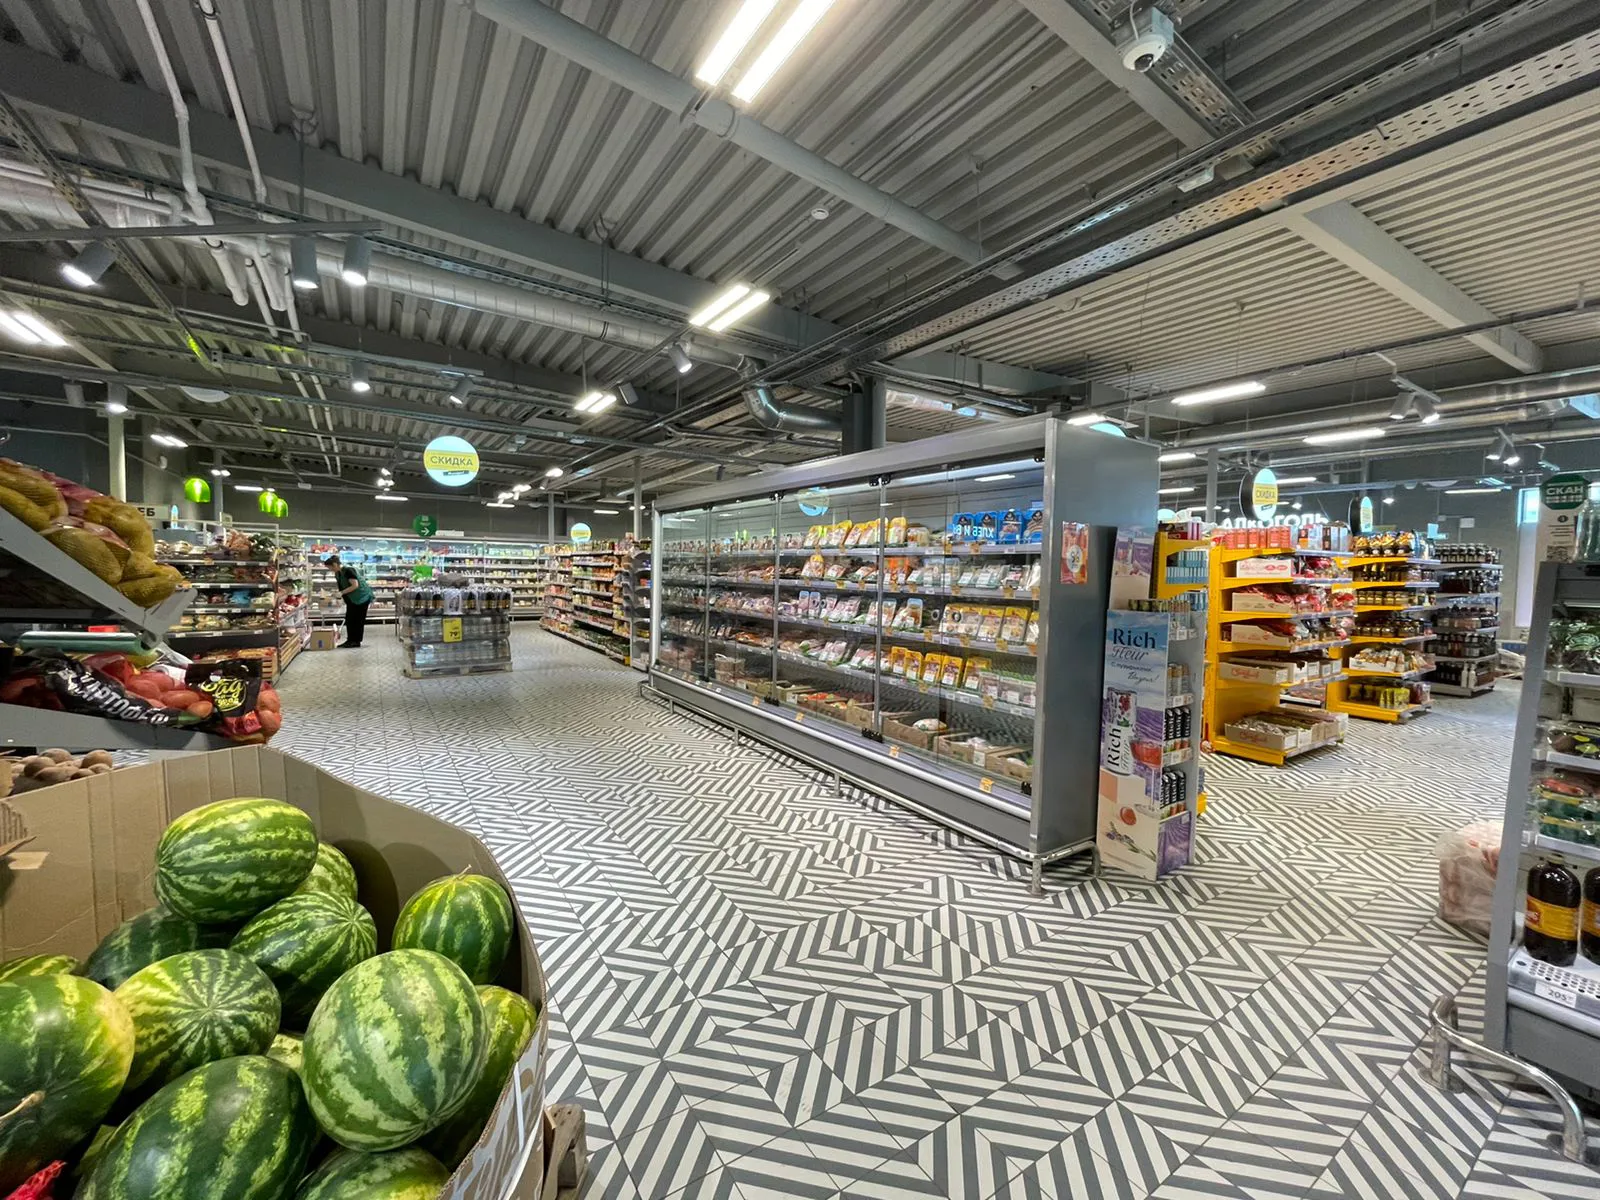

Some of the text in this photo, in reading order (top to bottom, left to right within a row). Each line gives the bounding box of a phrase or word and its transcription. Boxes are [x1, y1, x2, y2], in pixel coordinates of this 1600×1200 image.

[430, 455, 473, 466] СКИДКА
[1546, 486, 1584, 495] СКАН
[1112, 627, 1156, 649] Rich
[1112, 645, 1149, 661] Fleur
[1106, 727, 1122, 767] Rich
